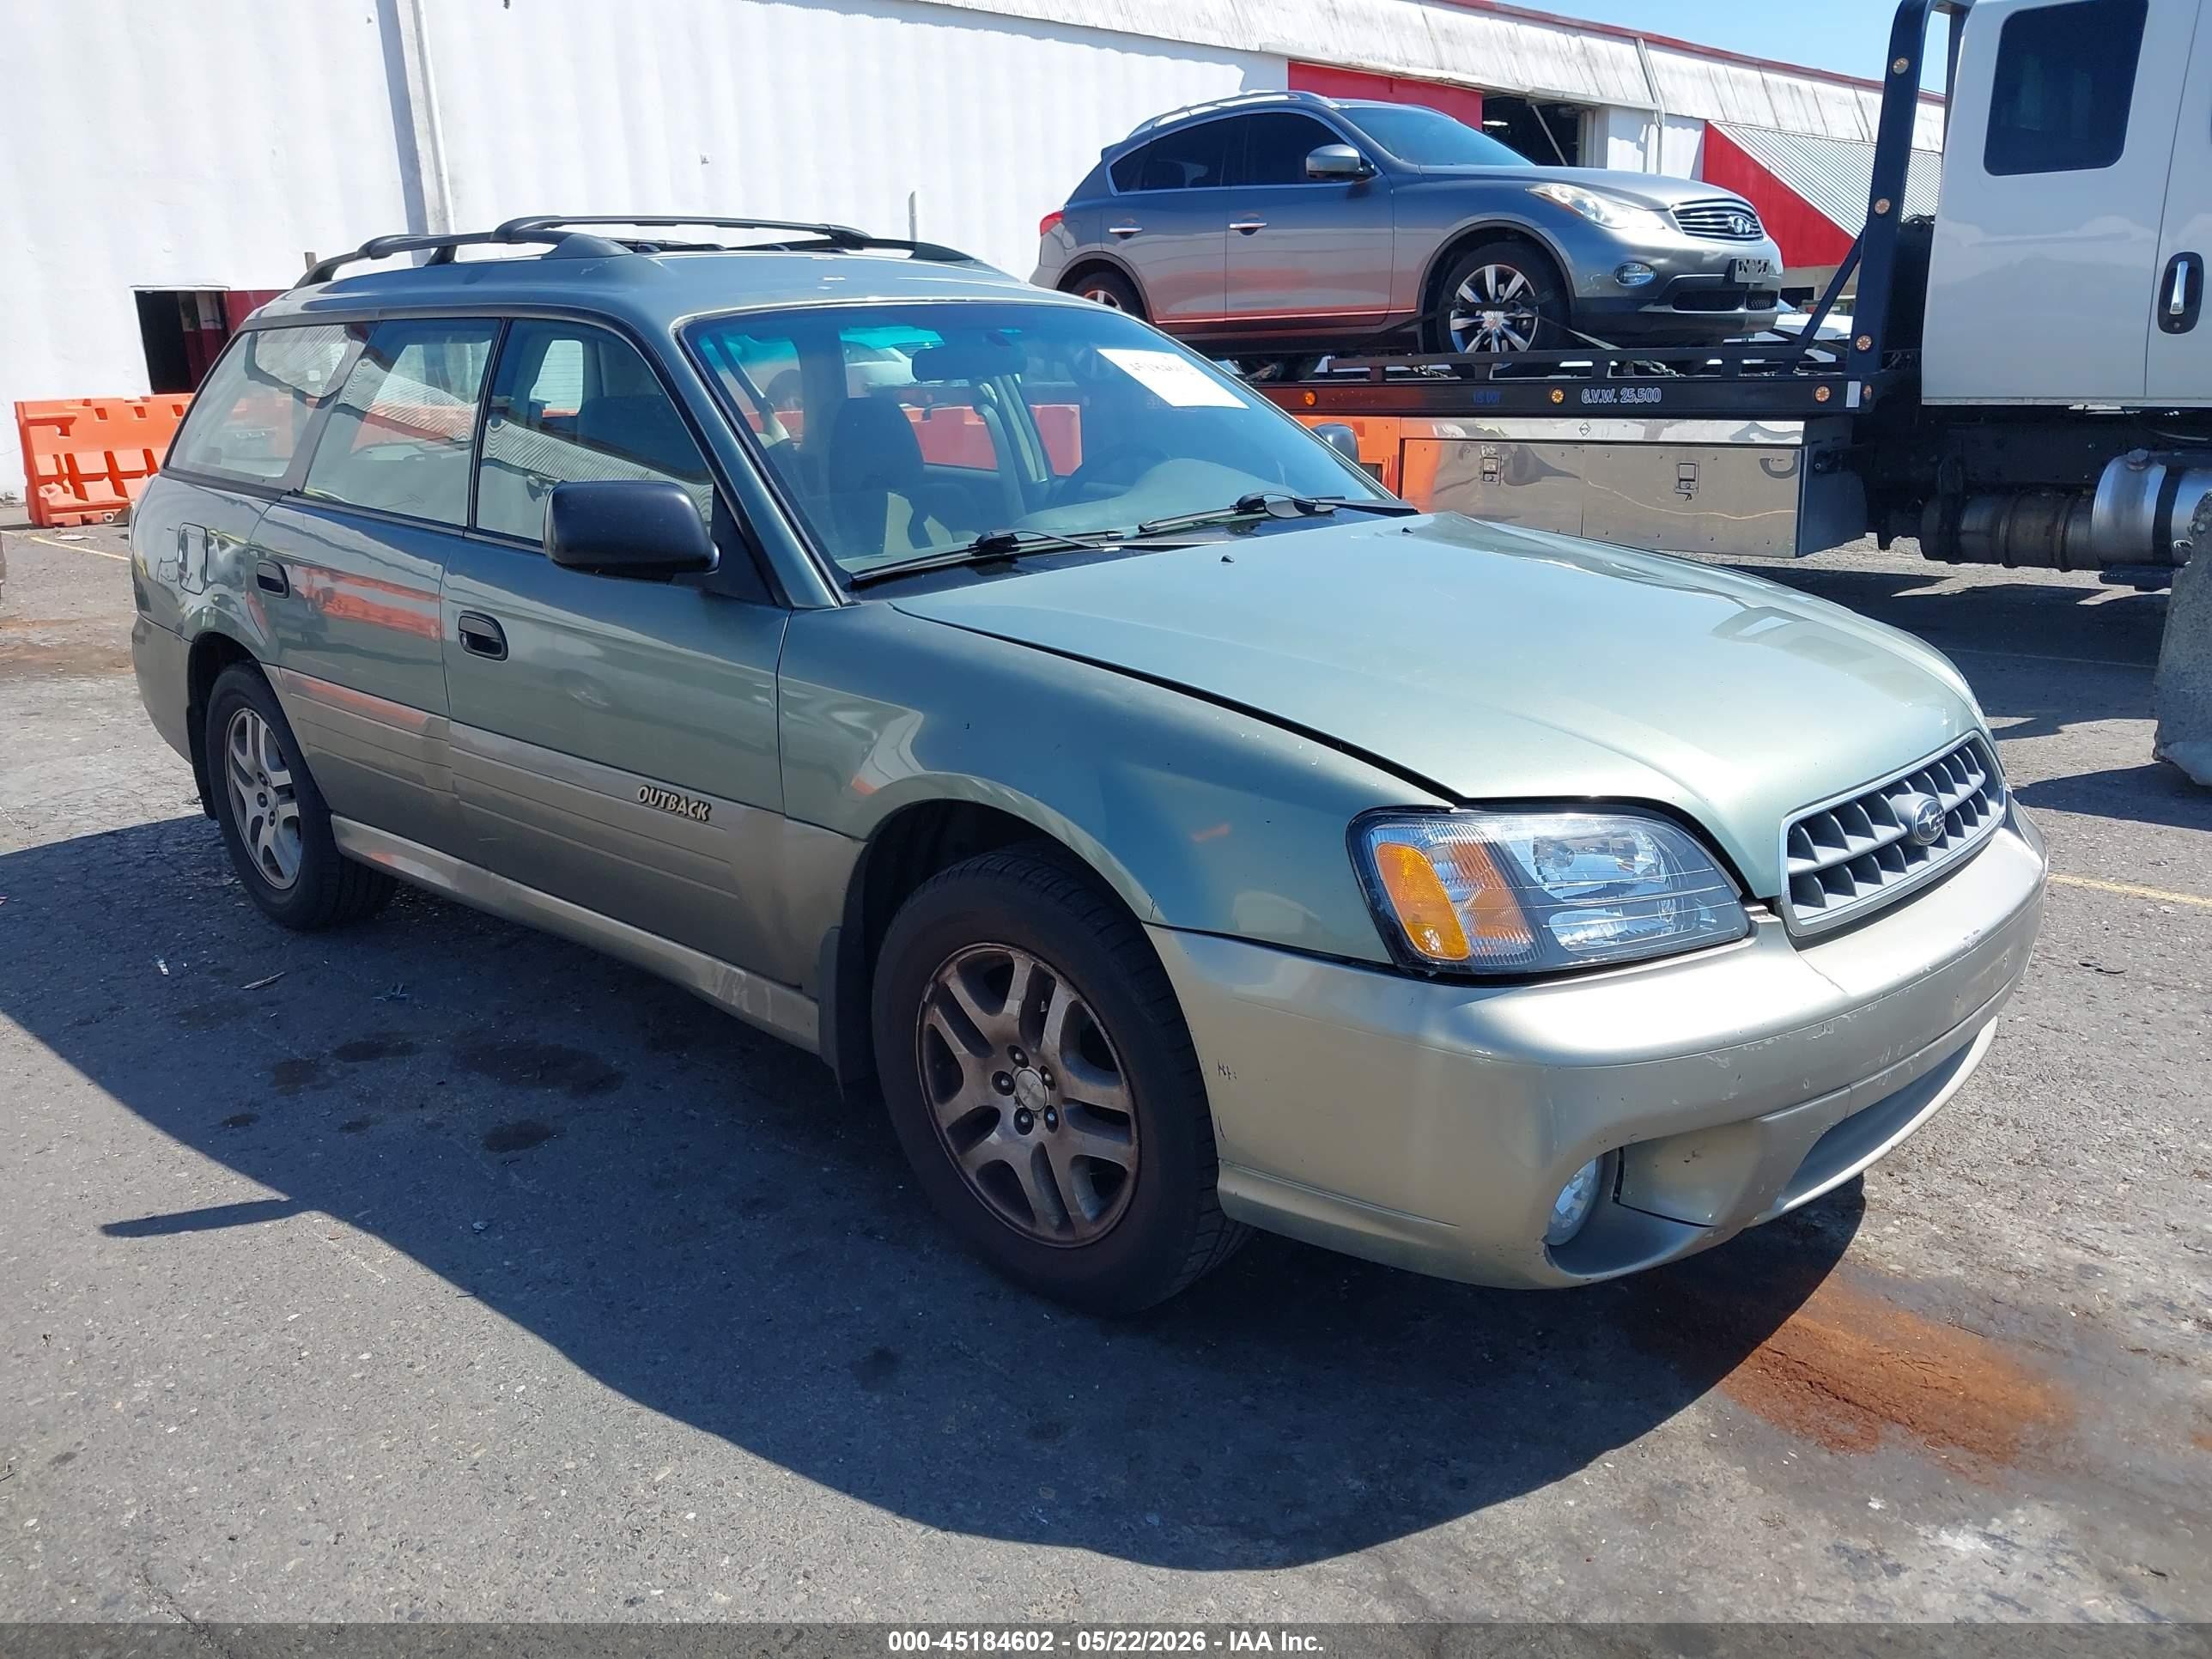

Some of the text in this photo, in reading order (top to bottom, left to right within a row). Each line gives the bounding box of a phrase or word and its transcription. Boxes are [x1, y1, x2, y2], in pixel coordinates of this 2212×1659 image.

[1581, 387, 1662, 404] G.V.W. 25,500
[637, 785, 712, 822] OUTBACK
